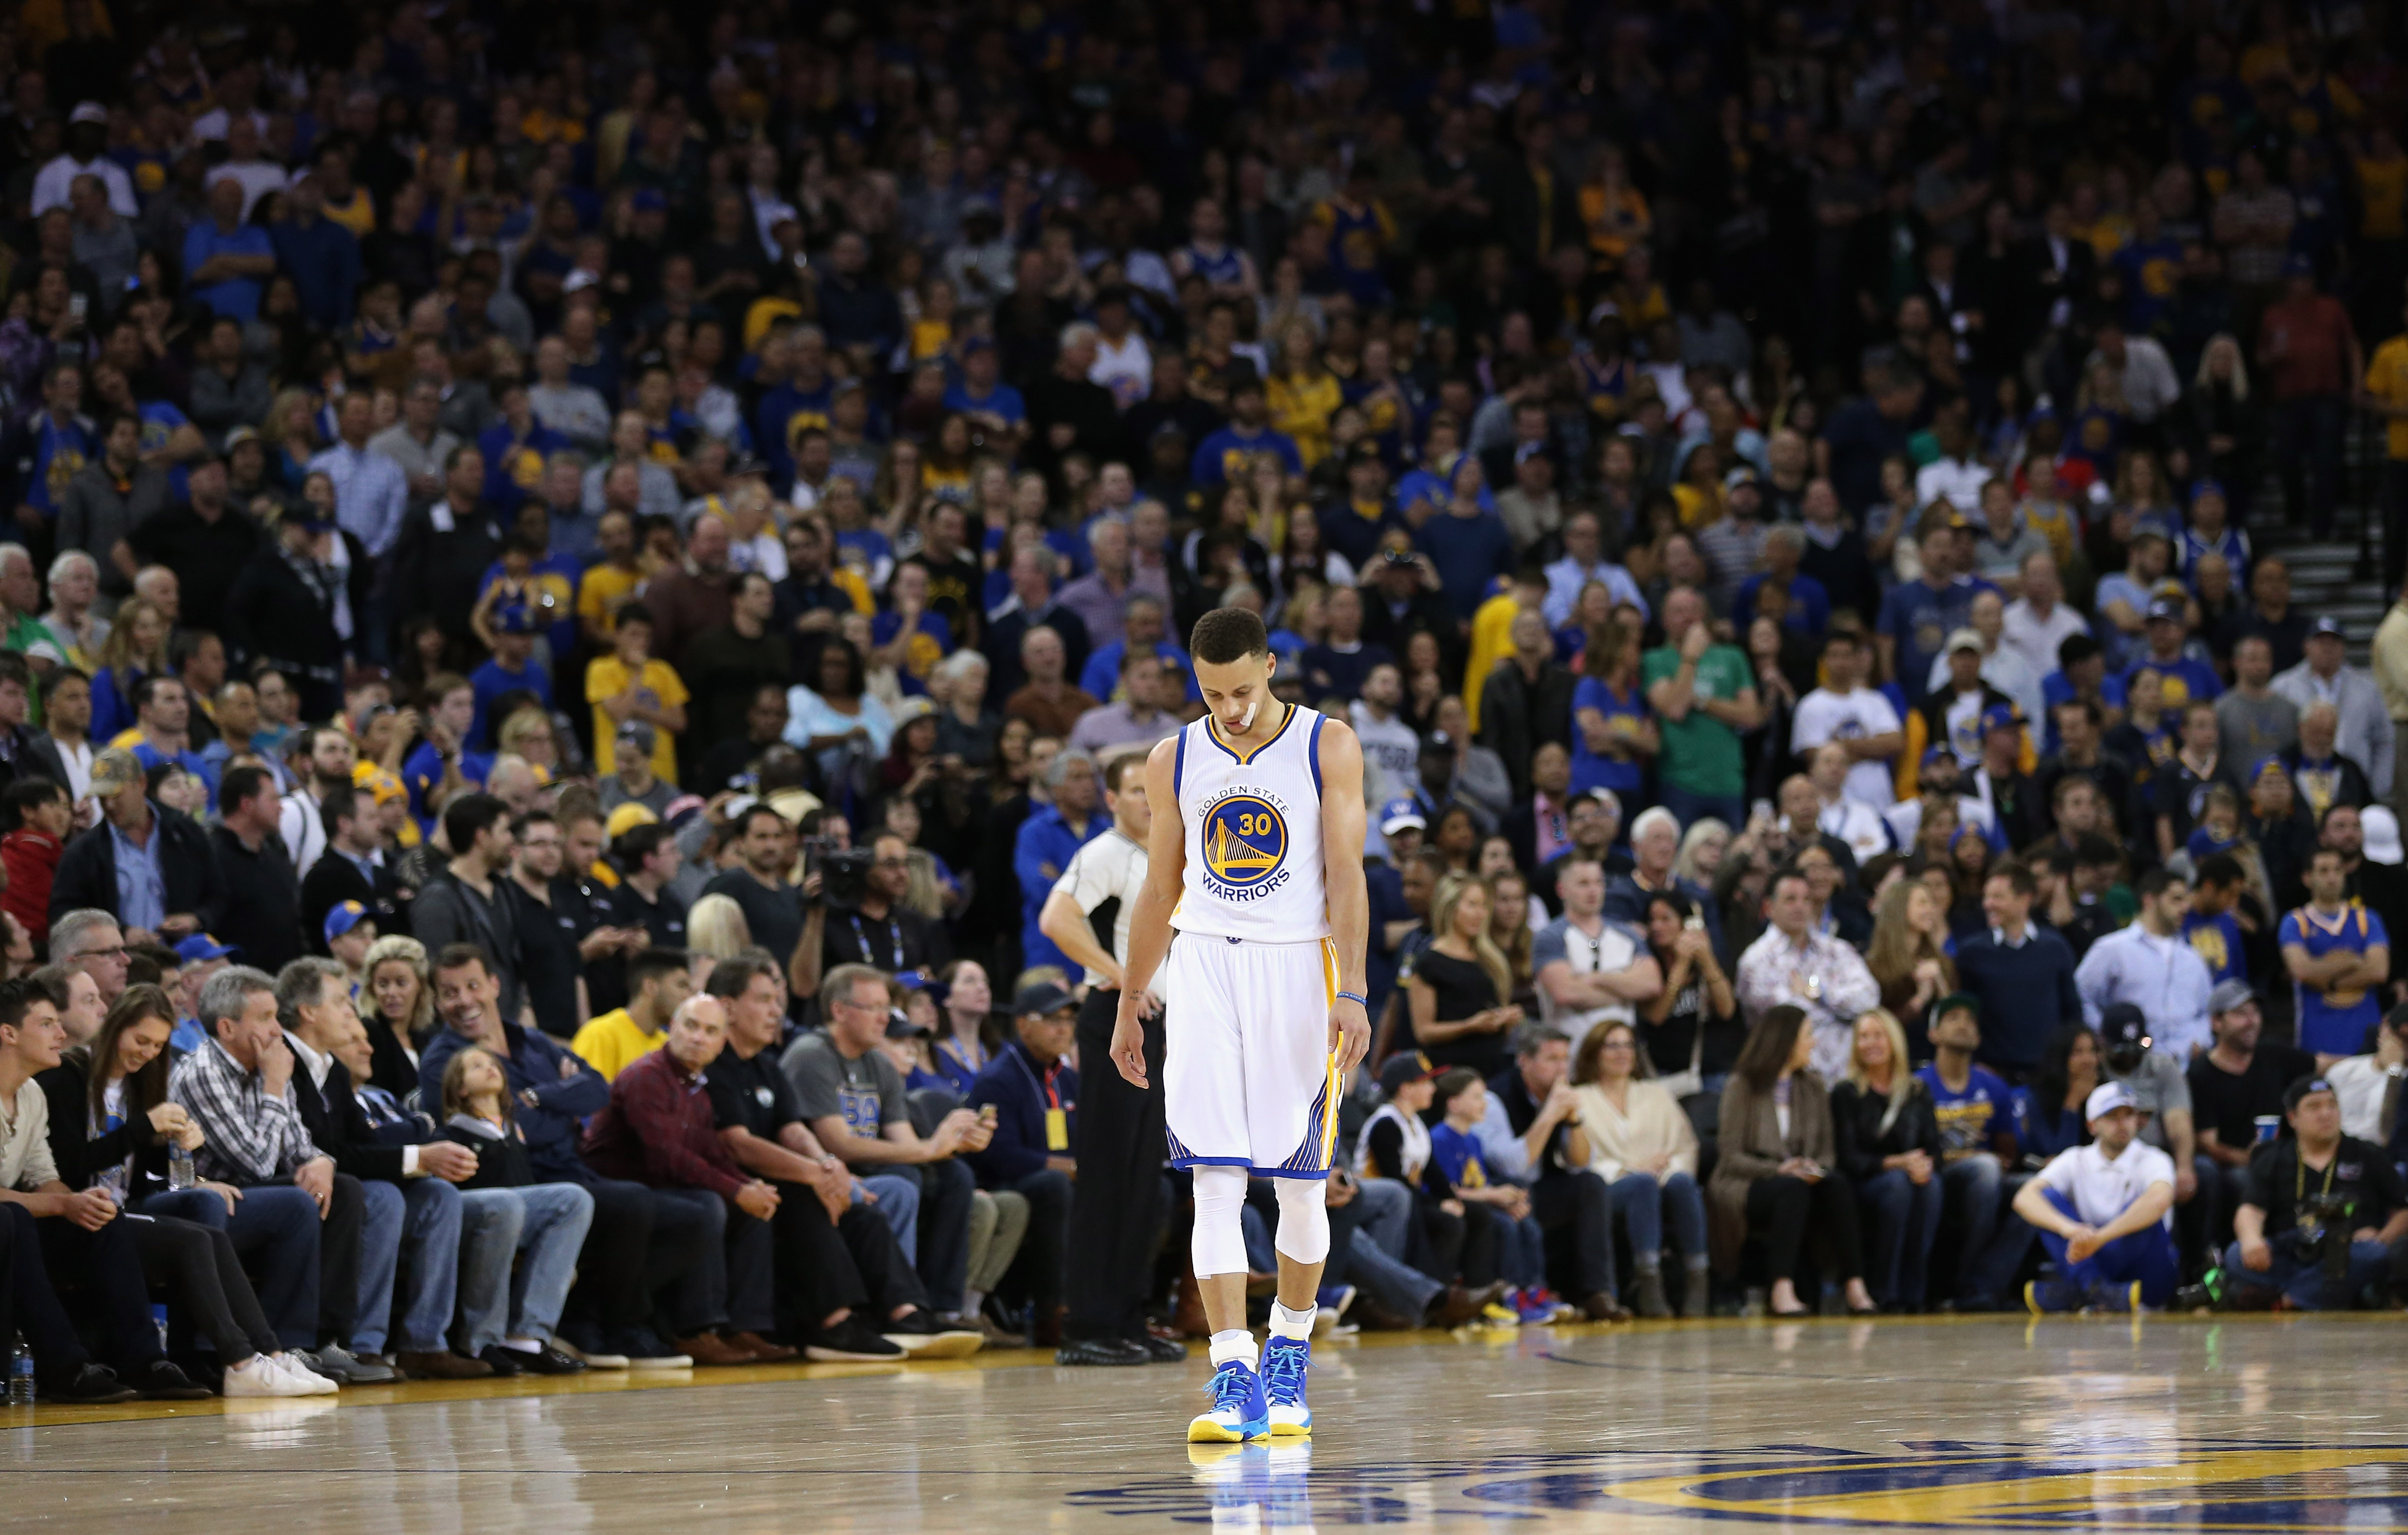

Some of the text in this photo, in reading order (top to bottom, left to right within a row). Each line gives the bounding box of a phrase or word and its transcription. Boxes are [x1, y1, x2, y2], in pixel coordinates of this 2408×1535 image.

[1198, 786, 1290, 817] GOLDEN STATE
[1238, 813, 1272, 836] 30
[1202, 868, 1290, 902] WARRIORS
